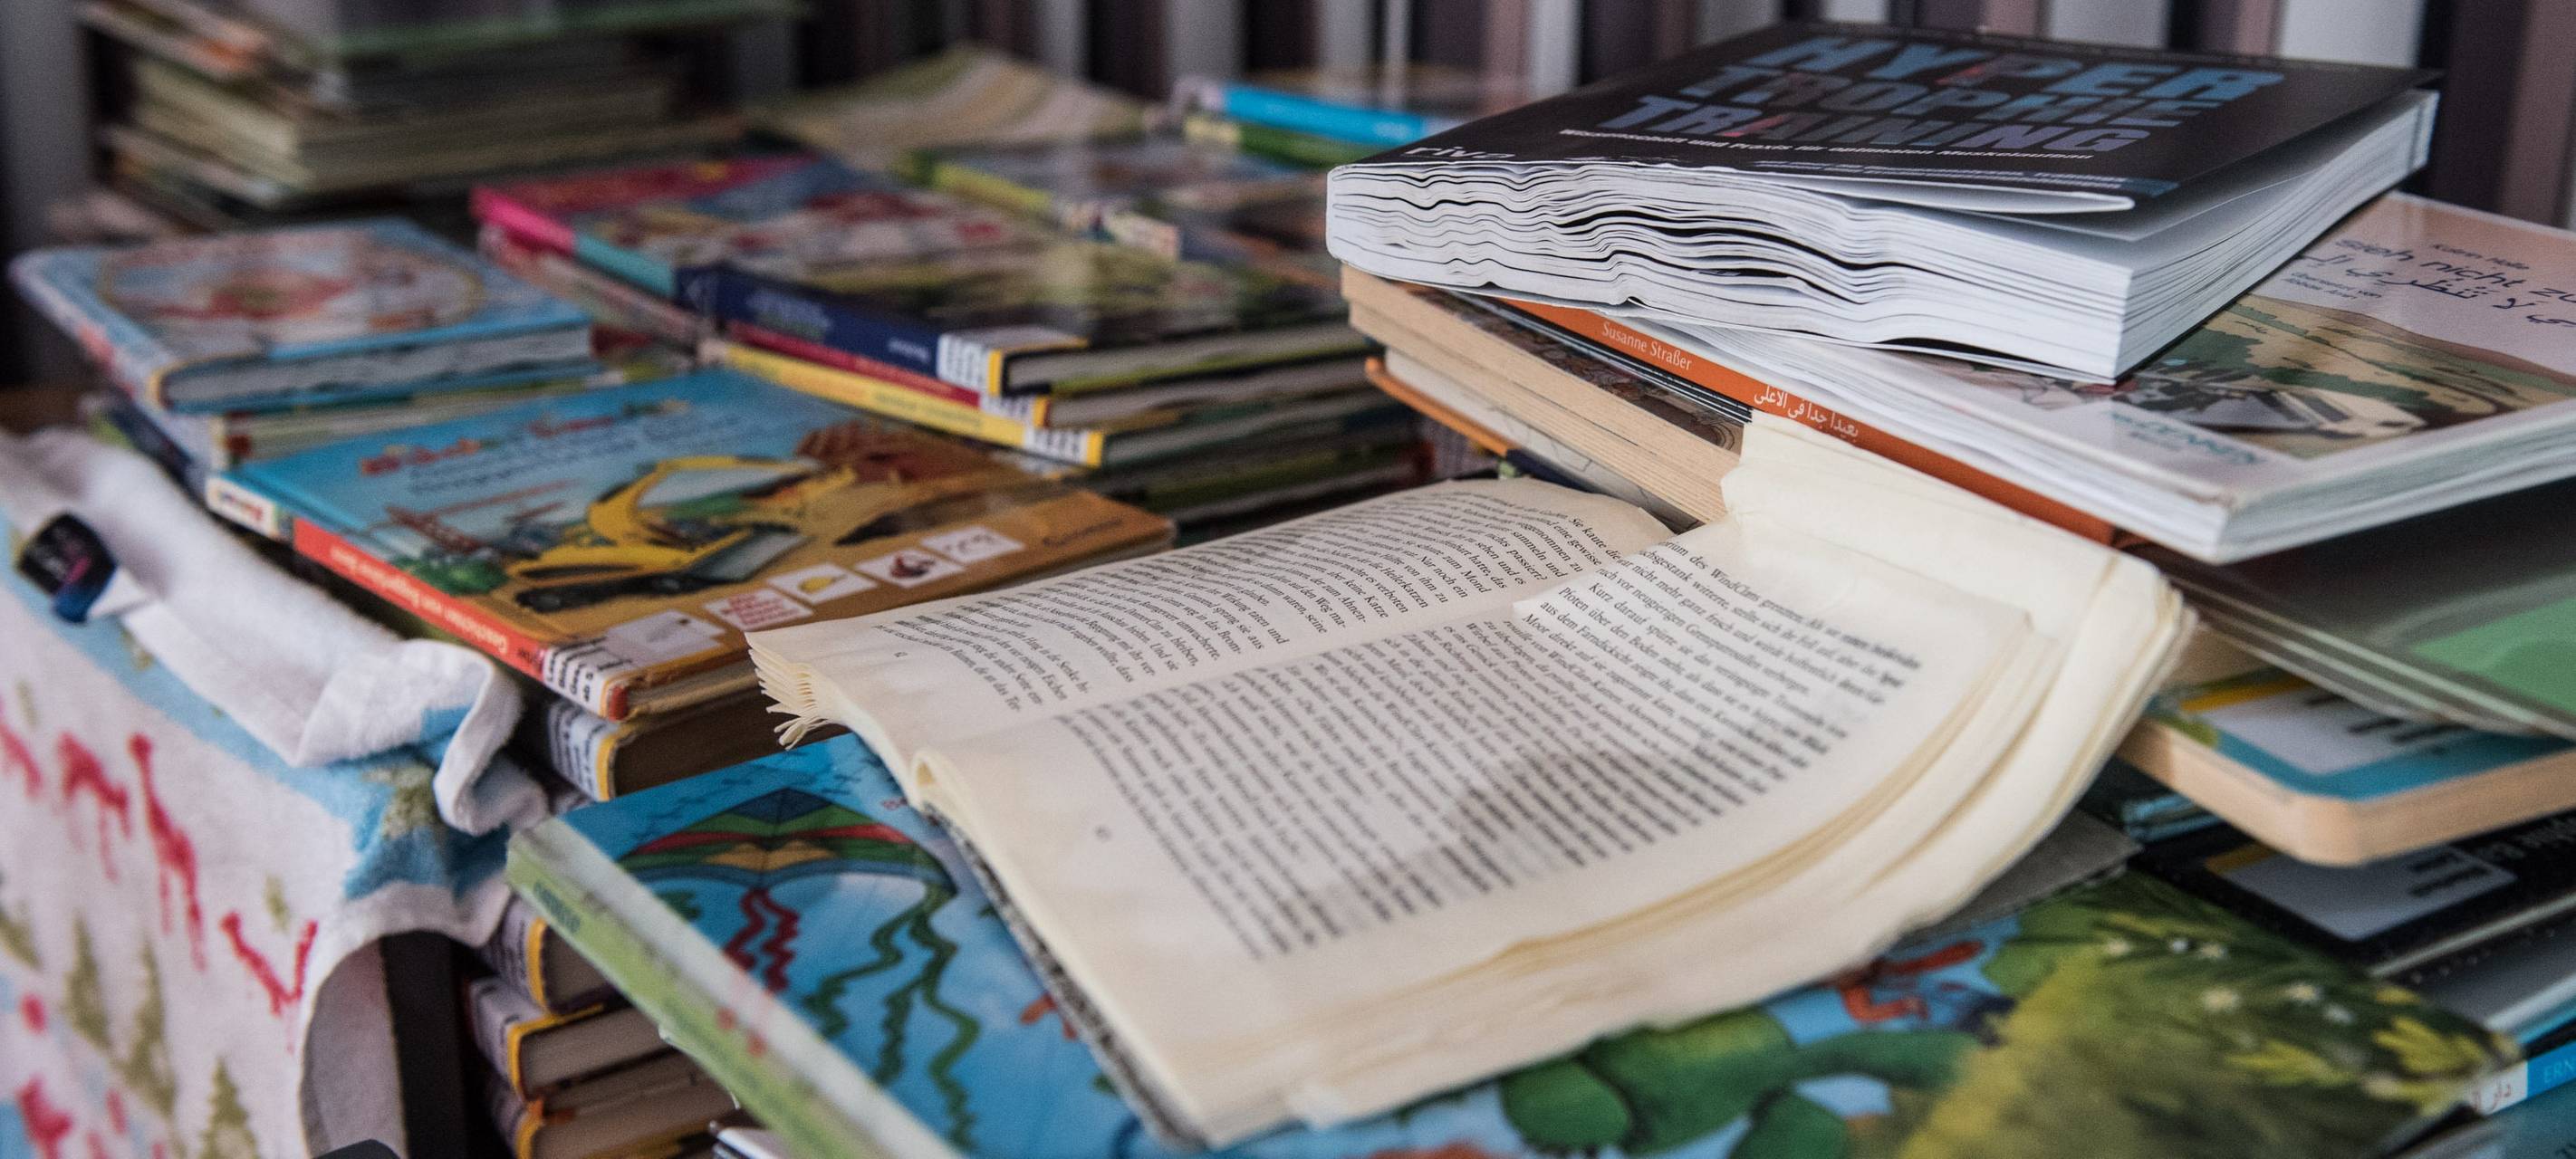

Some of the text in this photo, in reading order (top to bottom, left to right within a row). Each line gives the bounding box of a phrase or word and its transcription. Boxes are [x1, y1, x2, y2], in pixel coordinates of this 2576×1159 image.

[1743, 37, 2284, 101] HYPER
[1679, 65, 2225, 126] TROPHIE
[1595, 94, 2150, 152] TRAINING
[1404, 146, 1515, 158] riva
[2420, 260, 2527, 288] nicht
[1601, 321, 1693, 371] Susanne Straßer
[1569, 536, 1602, 566] gewisse
[1583, 528, 1607, 549] kaute
[1498, 561, 1521, 576] und
[1507, 549, 1548, 580] passiert?
[1511, 531, 1569, 578] sammeln und
[1570, 562, 1584, 572] zu
[1688, 555, 1709, 571] des
[1379, 567, 1429, 609] Heilerkatzen
[1405, 565, 1449, 603] von ihm zu
[1434, 568, 1456, 585] noch
[1453, 585, 1469, 599] ein
[1460, 570, 1493, 594] Mond
[1490, 576, 1507, 589] das
[1631, 563, 1657, 584] nicht
[1655, 580, 1684, 599] mehr
[1315, 596, 1334, 614] Weg
[1338, 595, 1368, 624] Ahnen-
[1363, 595, 1390, 618] Katze
[1374, 582, 1409, 615] verboten
[1559, 586, 1591, 612] Pfoten
[1588, 608, 1613, 628] über
[1610, 623, 1631, 639] den
[1588, 582, 1616, 604] Kurz
[1613, 600, 1650, 627] darauf
[1617, 577, 1634, 591] vor
[1631, 588, 1687, 628] neugierigen
[1305, 614, 1329, 635] seine
[1523, 613, 1552, 635] Moor
[1540, 600, 1560, 617] aus
[1556, 612, 1580, 631] dem
[1247, 635, 1265, 650] aus
[1268, 627, 1292, 646] und
